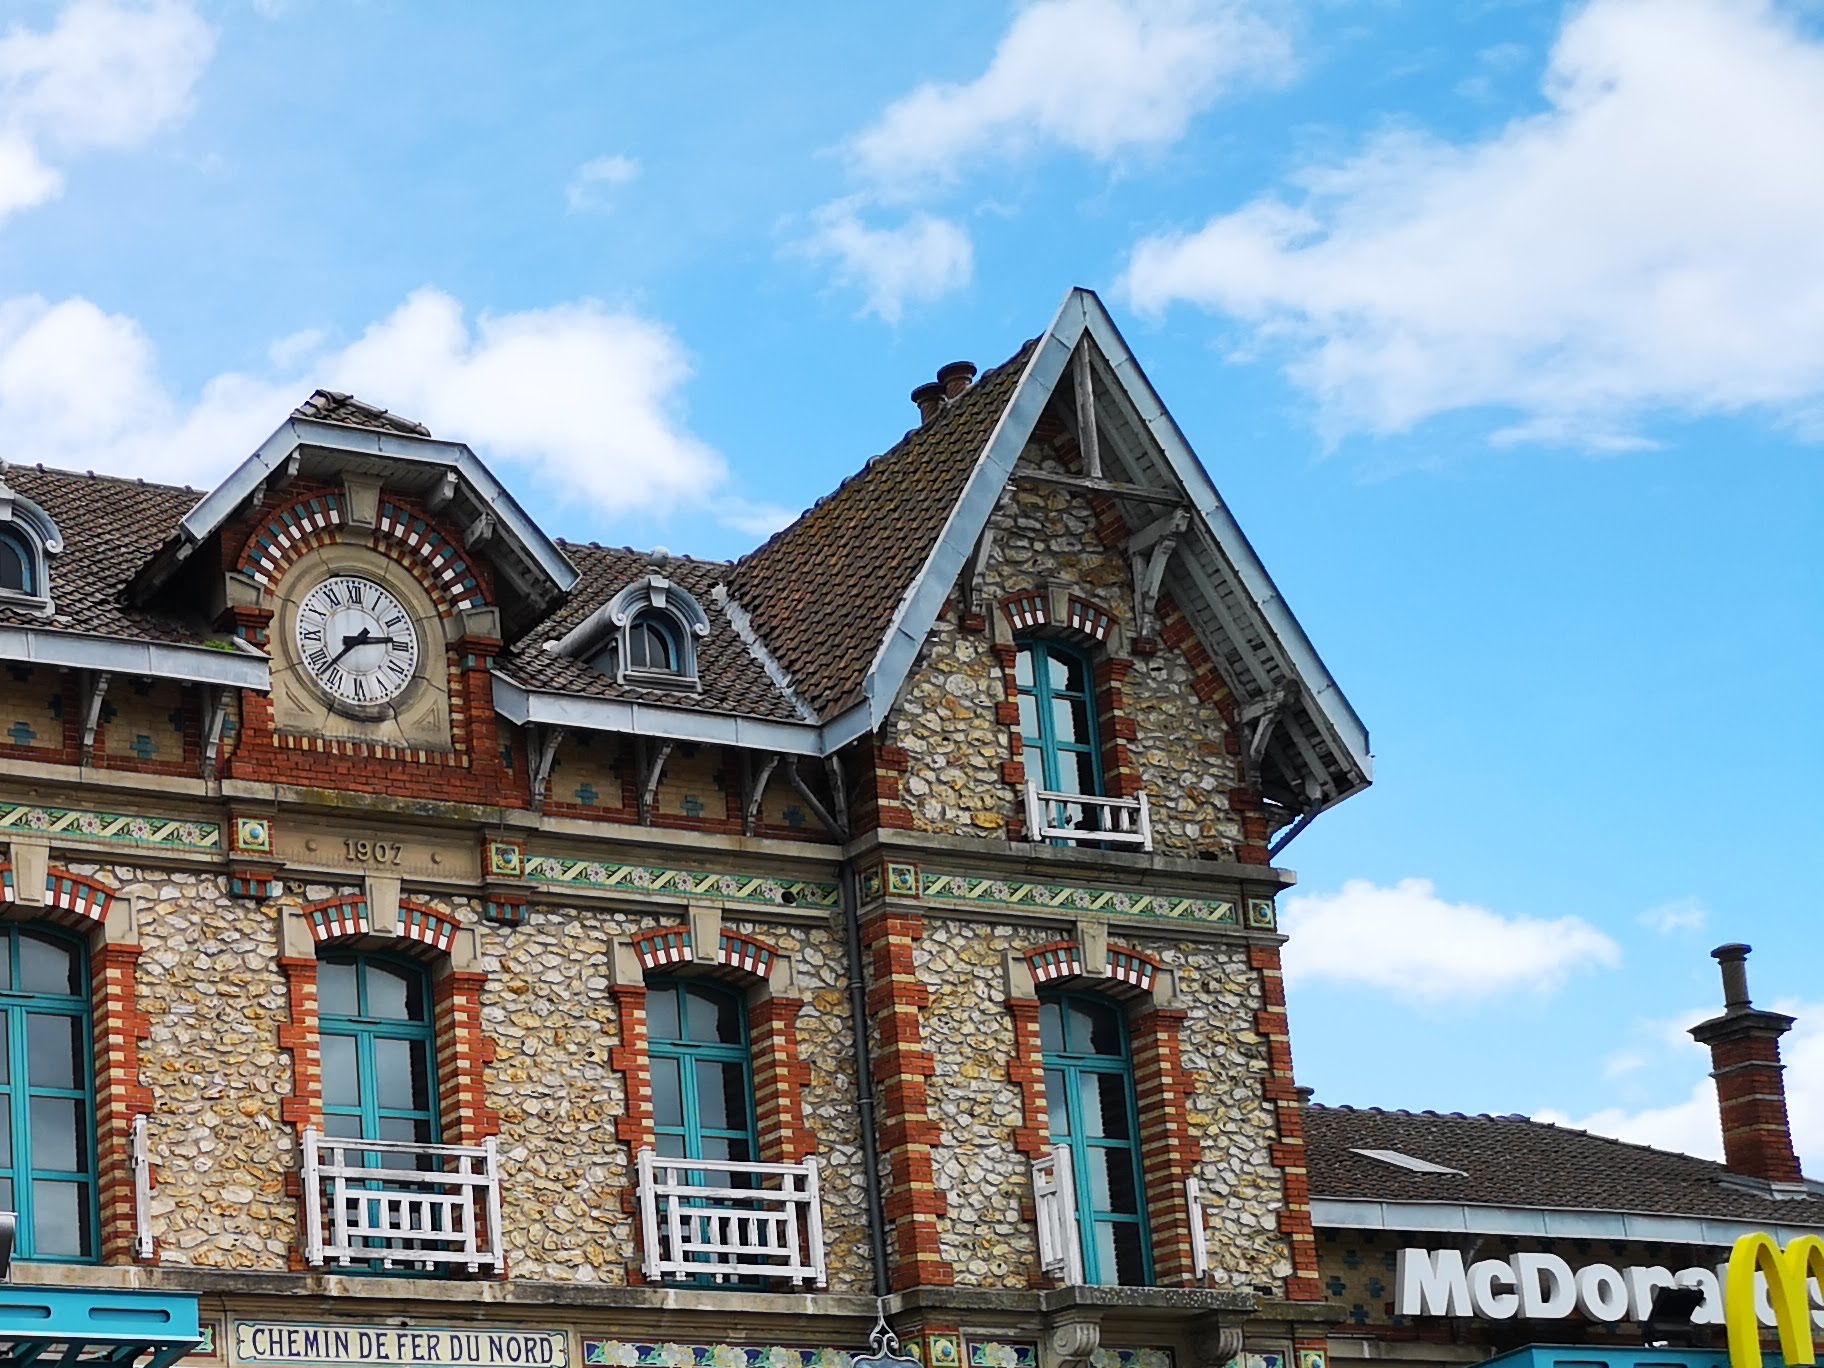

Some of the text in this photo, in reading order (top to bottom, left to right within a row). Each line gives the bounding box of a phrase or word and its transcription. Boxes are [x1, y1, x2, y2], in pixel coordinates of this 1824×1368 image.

[344, 838, 404, 866] 1907
[252, 1328, 554, 1364] CHEMIN DE FER DU NORD
